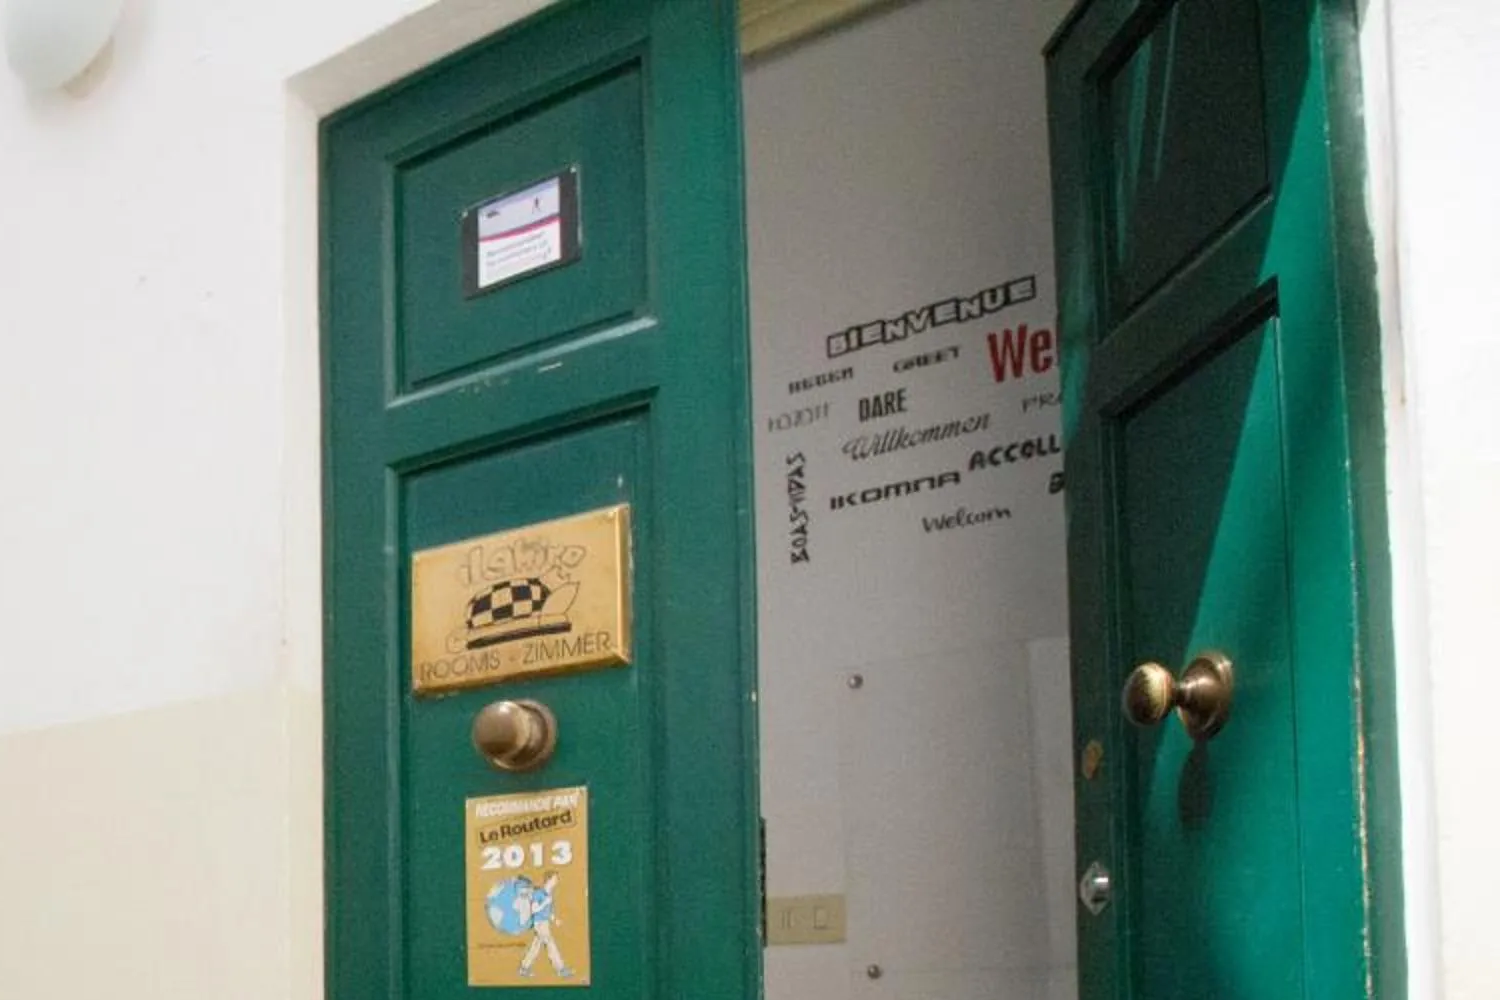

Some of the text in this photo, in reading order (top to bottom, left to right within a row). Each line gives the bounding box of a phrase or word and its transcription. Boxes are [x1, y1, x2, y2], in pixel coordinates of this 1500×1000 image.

[826, 275, 1036, 358] BIENVENUE
[987, 323, 1059, 382] We
[858, 388, 907, 422] DARE
[841, 413, 990, 461] Willkommen
[420, 631, 611, 681] ROOMS ZIMMER
[500, 809, 573, 839] Routard
[480, 840, 573, 871] 2013
